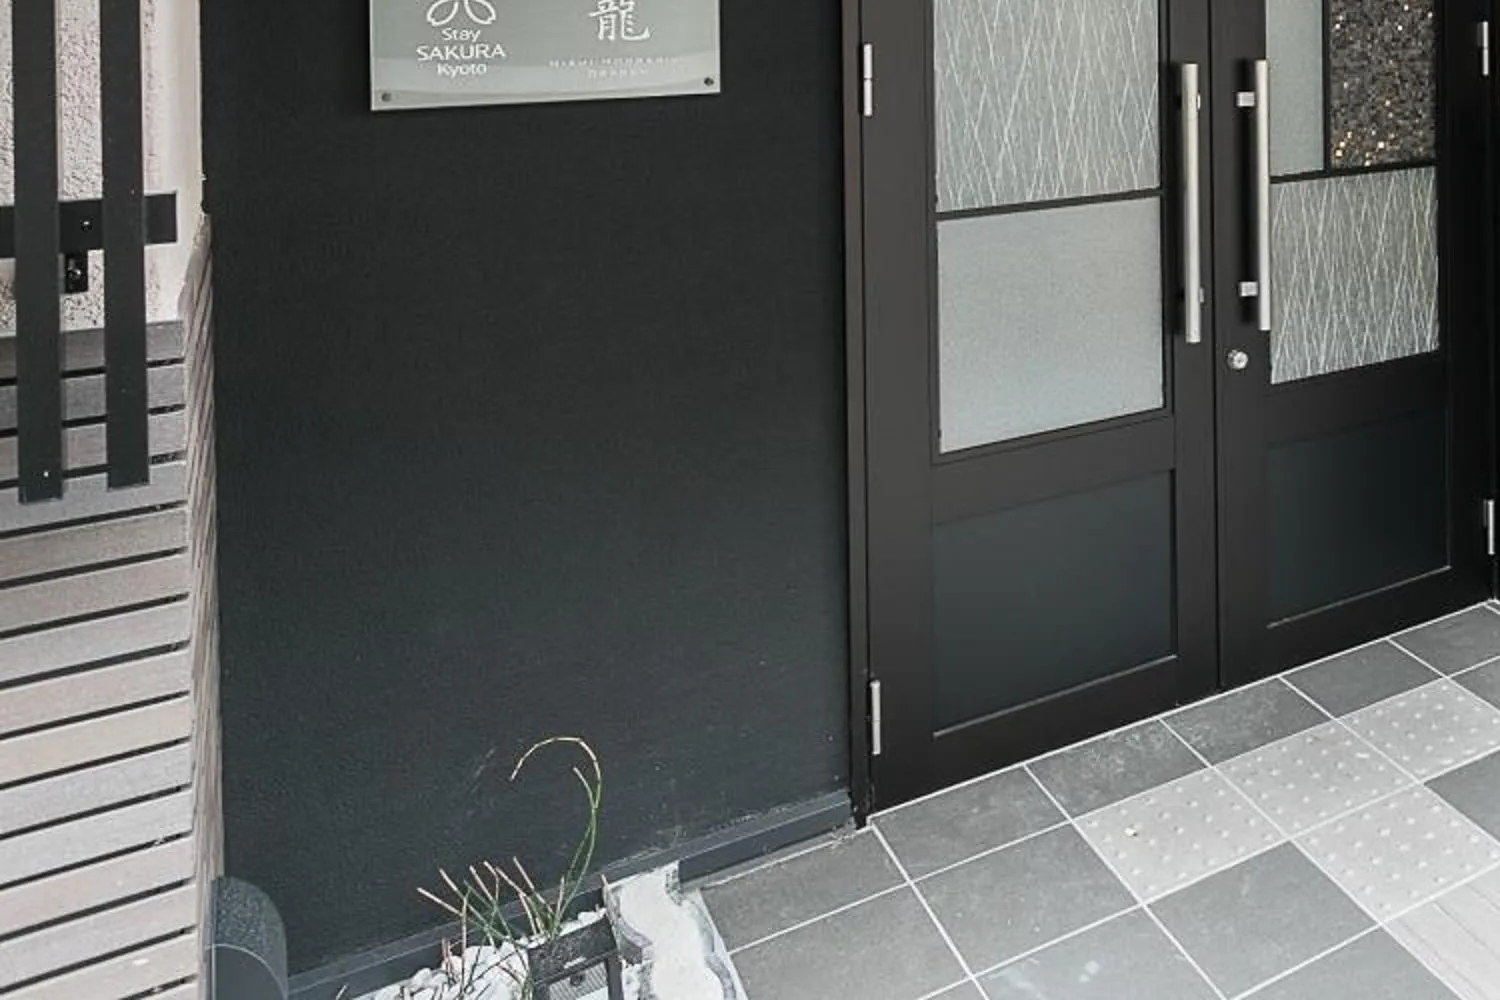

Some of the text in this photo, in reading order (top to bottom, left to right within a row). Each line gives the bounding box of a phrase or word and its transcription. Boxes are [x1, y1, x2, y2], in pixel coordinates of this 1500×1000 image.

[441, 27, 481, 42] Stay
[416, 43, 507, 61] SAKURA
[437, 62, 488, 78] Kyoto
